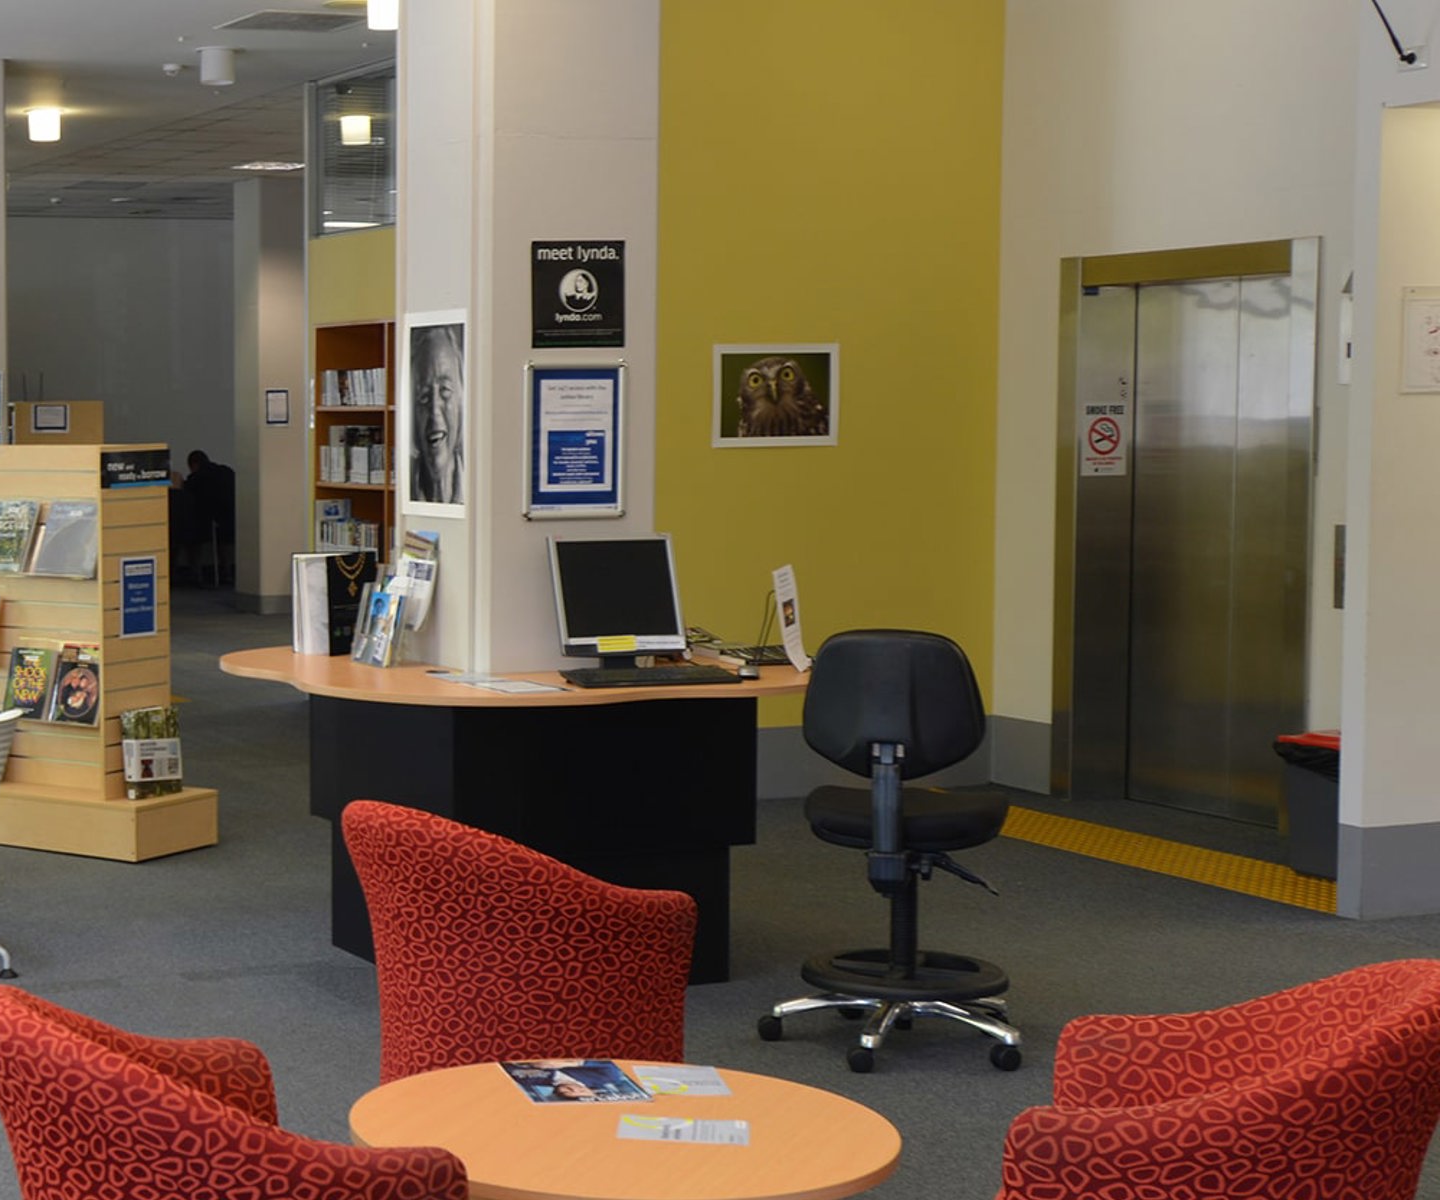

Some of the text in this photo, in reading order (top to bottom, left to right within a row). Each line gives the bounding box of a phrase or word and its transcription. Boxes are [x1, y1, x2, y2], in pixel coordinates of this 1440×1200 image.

[537, 246, 619, 262] meet lynda.
[555, 312, 603, 323] lynda.com
[1086, 405, 1124, 415] SMOKE FREE
[107, 462, 125, 472] new
[141, 469, 167, 479] borrow
[15, 665, 47, 680] SHOCK
